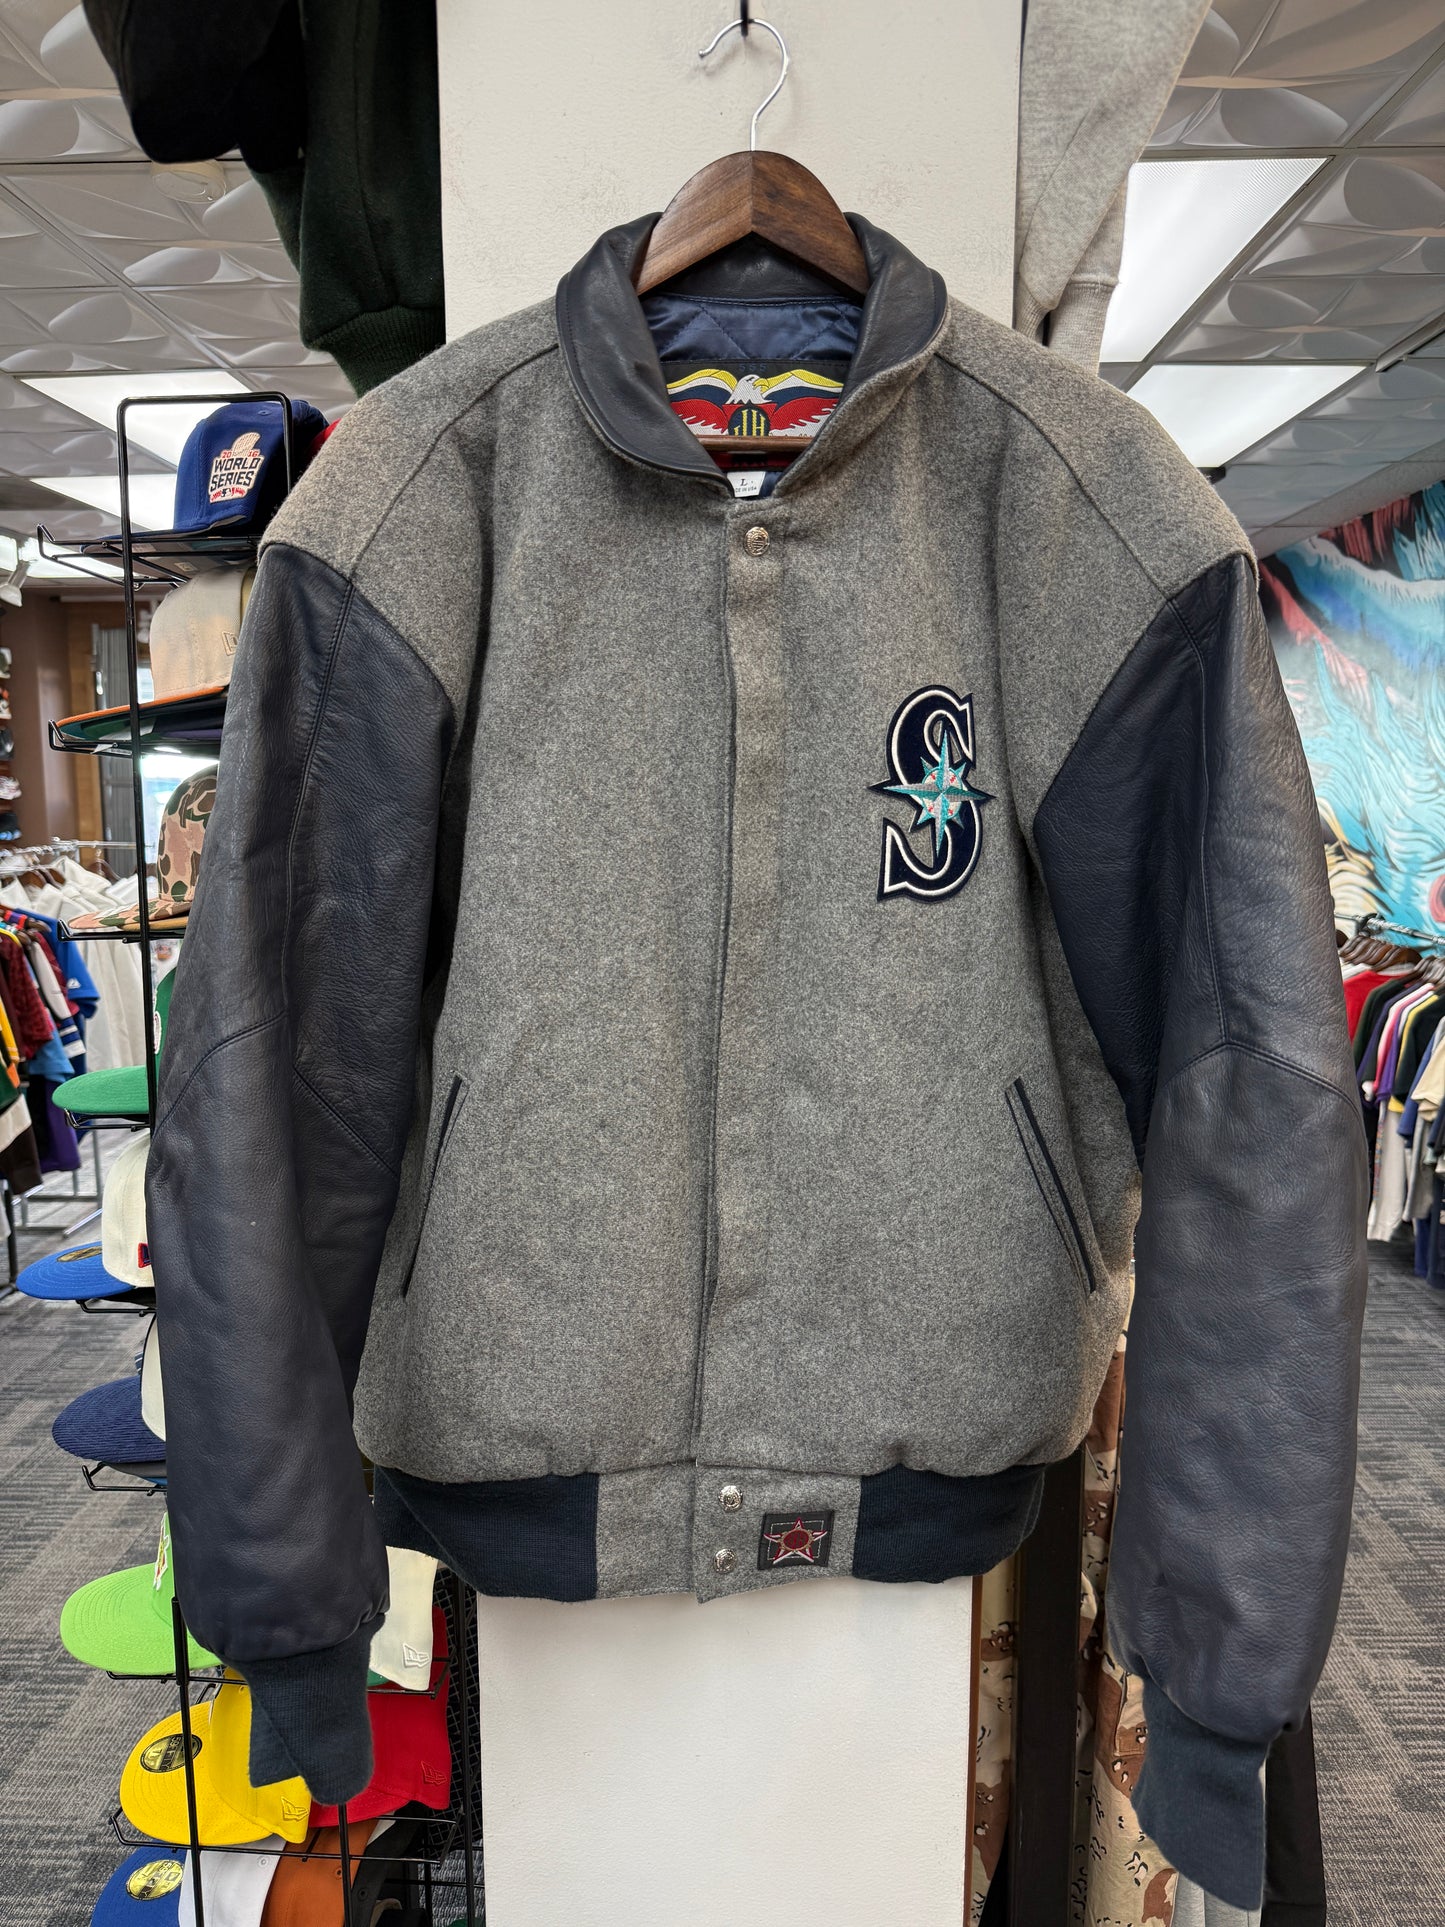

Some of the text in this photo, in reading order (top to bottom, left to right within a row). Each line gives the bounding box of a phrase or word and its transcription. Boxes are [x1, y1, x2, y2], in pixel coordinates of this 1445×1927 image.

[221, 450, 259, 459] 20 16
[214, 457, 261, 473] WORLD
[210, 470, 255, 492] SERIES
[740, 478, 748, 487] L
[877, 684, 983, 903] S
